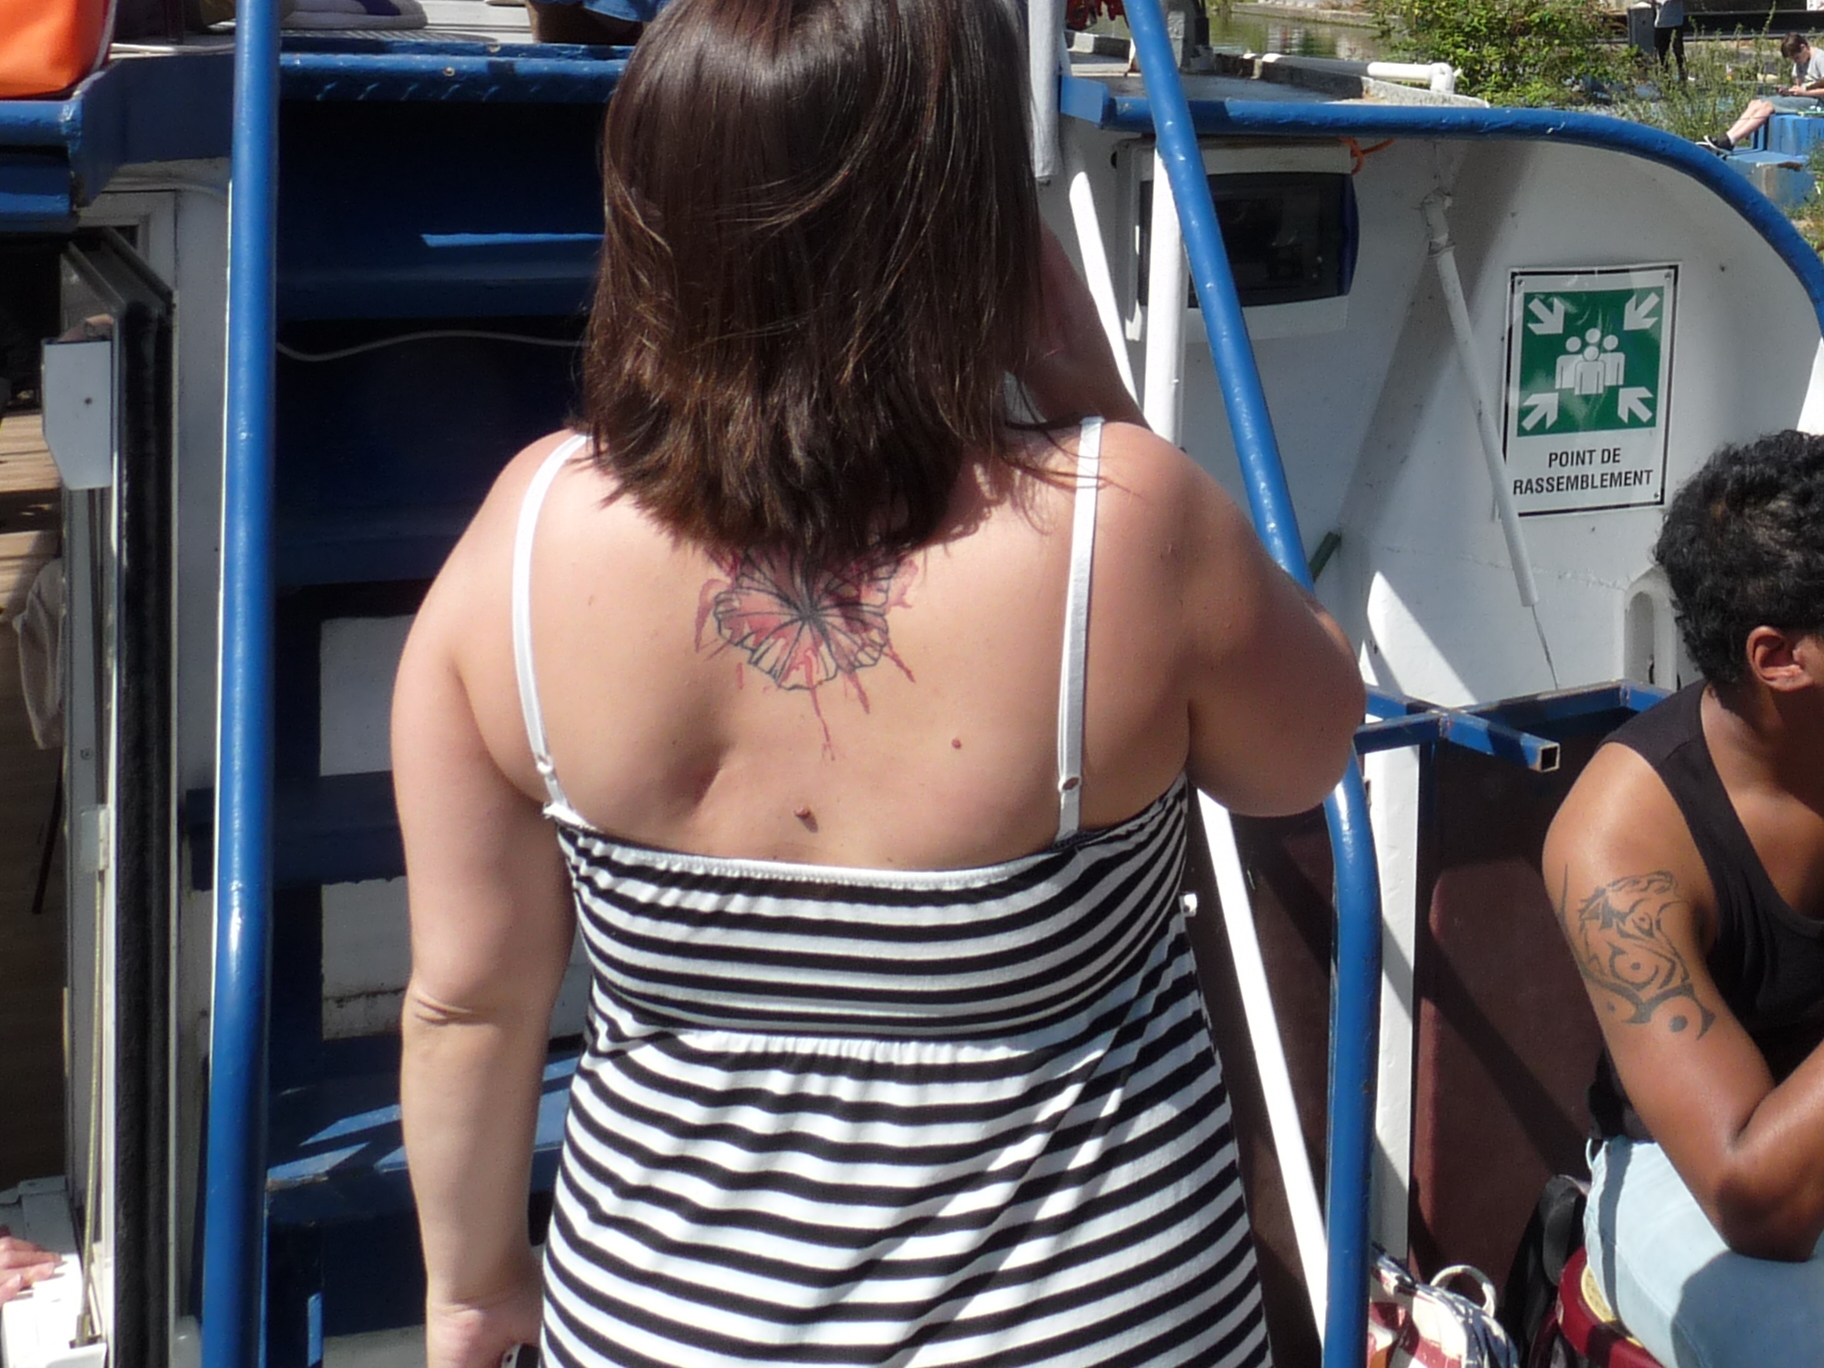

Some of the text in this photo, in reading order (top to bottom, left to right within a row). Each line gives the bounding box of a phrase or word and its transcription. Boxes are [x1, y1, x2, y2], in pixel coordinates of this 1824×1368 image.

[1548, 447, 1622, 469] POINT DE
[1512, 469, 1654, 496] RASSEMBLEMENT
